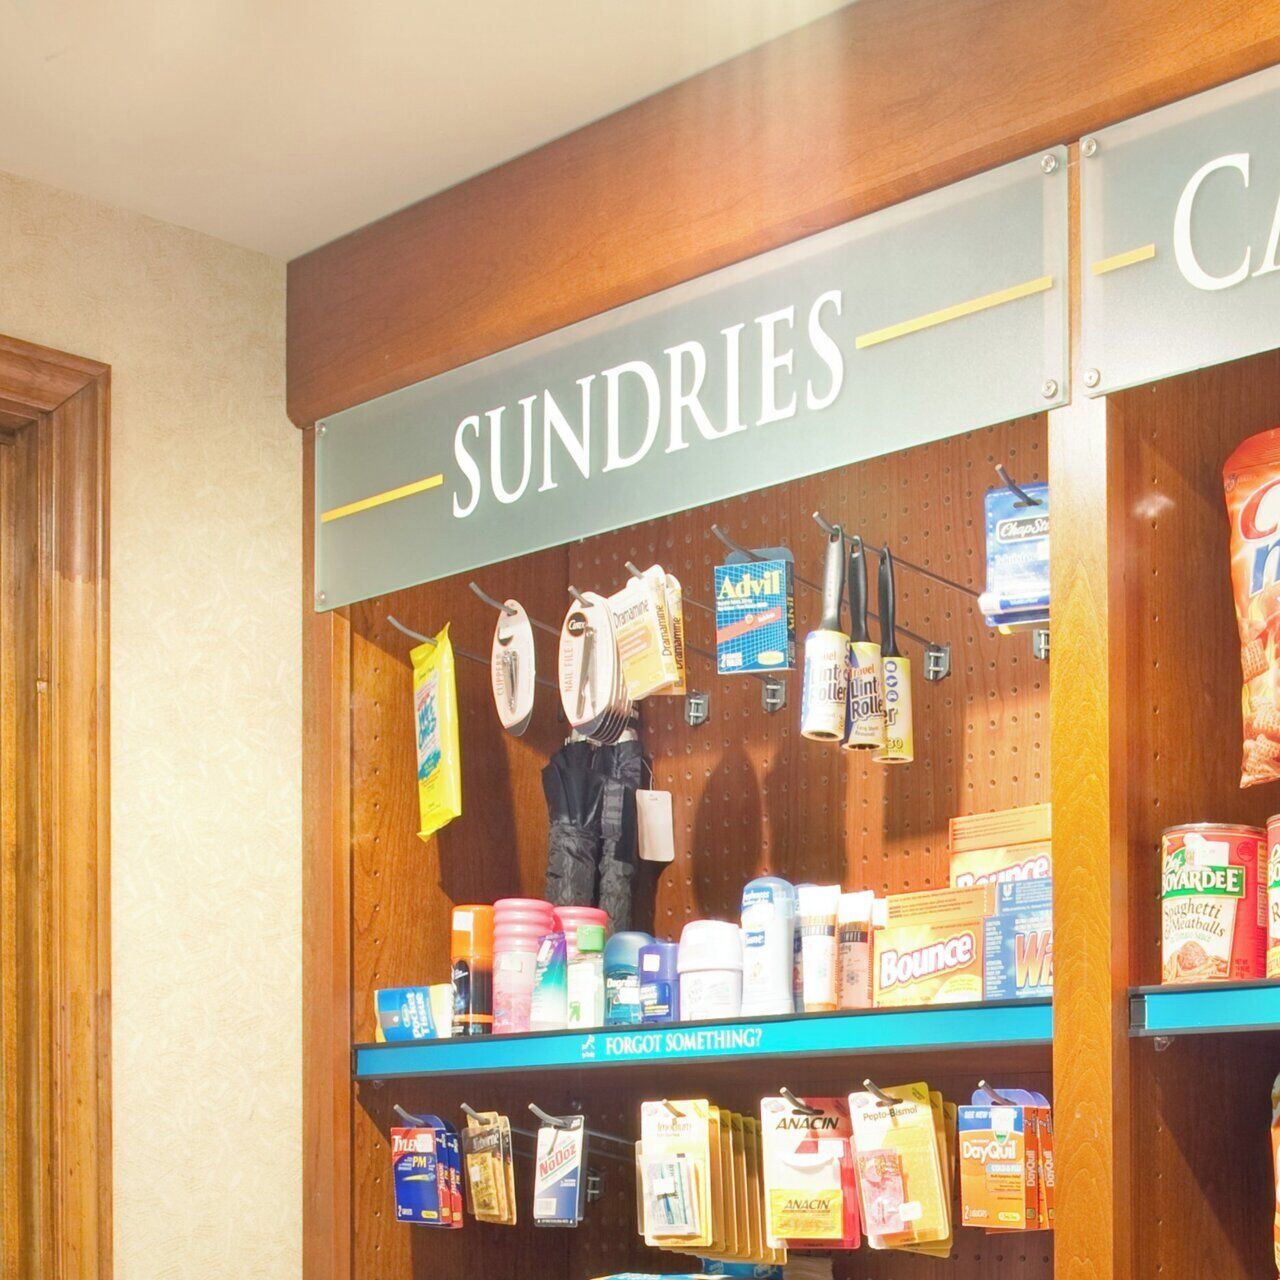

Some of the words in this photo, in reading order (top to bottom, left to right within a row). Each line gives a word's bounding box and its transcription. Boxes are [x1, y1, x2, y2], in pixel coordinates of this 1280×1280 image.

[451, 289, 846, 520] SUNDRIES
[719, 569, 783, 599] Advil
[613, 599, 649, 630] Dramamine
[850, 678, 878, 699] Lint
[1161, 866, 1242, 897] BOYARDEE
[1163, 897, 1223, 921] Spaghetti
[1172, 913, 1226, 937] Meatballs
[879, 931, 975, 991] Bounce
[605, 1033, 662, 1056] FORGOT
[664, 1027, 763, 1053] SOMETHING?
[775, 1116, 840, 1131] ANACIN
[862, 1105, 918, 1122] Pepto-Bismol
[412, 1155, 427, 1169] PM
[539, 1144, 577, 1177] NoDoz
[963, 1139, 1016, 1164] DayQuil
[1026, 1149, 1036, 1188] DayQuil
[784, 1198, 831, 1211] ANACIN
